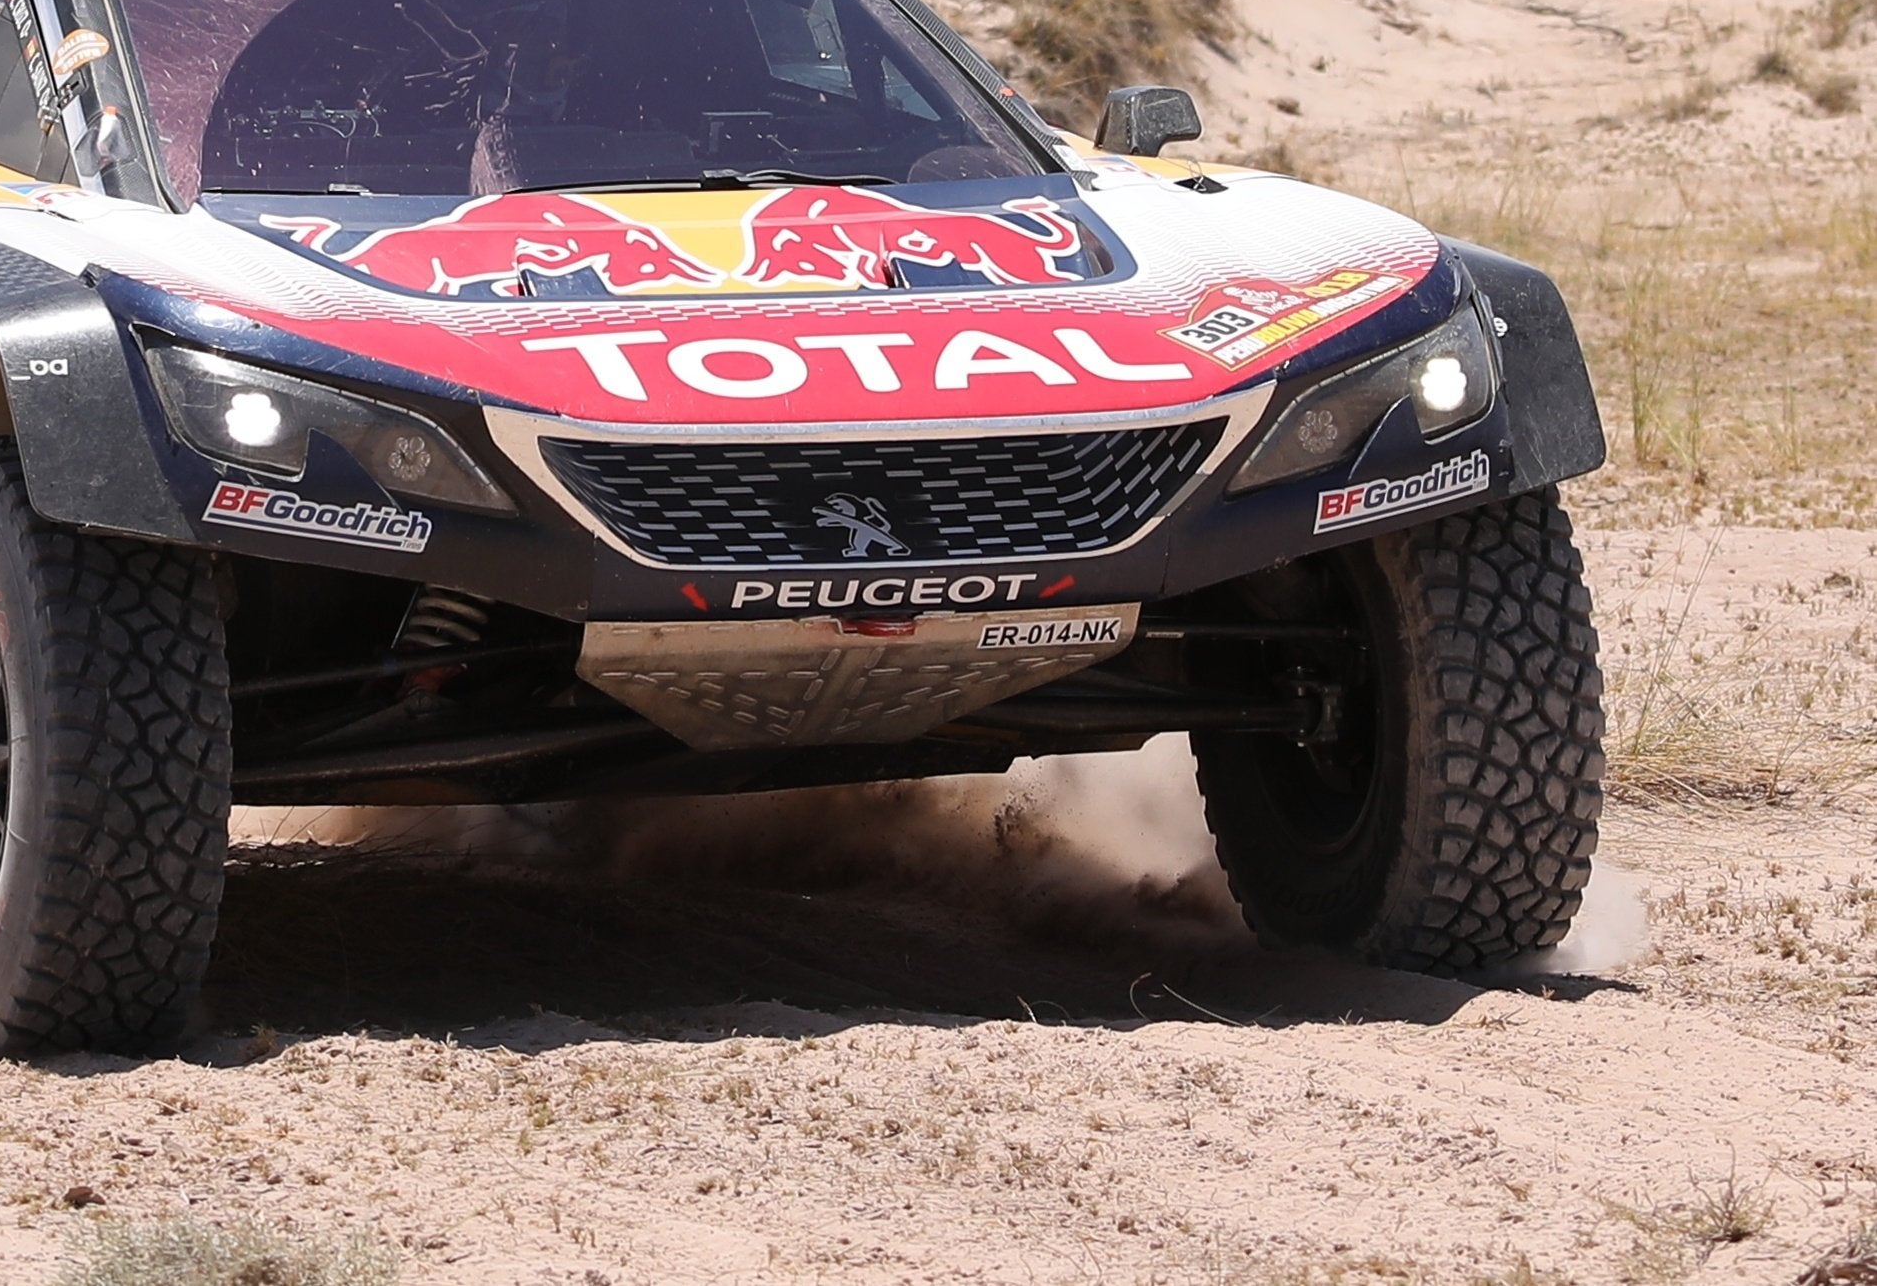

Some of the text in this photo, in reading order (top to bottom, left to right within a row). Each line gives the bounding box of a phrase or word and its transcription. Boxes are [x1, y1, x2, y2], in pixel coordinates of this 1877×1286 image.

[1180, 311, 1255, 345] 303
[521, 329, 1193, 402] TOTAL
[1320, 453, 1488, 520] BFGoodrich
[211, 485, 432, 540] BFGoodrich
[731, 573, 1038, 609] PEUGEOT
[980, 619, 1119, 648] ER-014-NK
